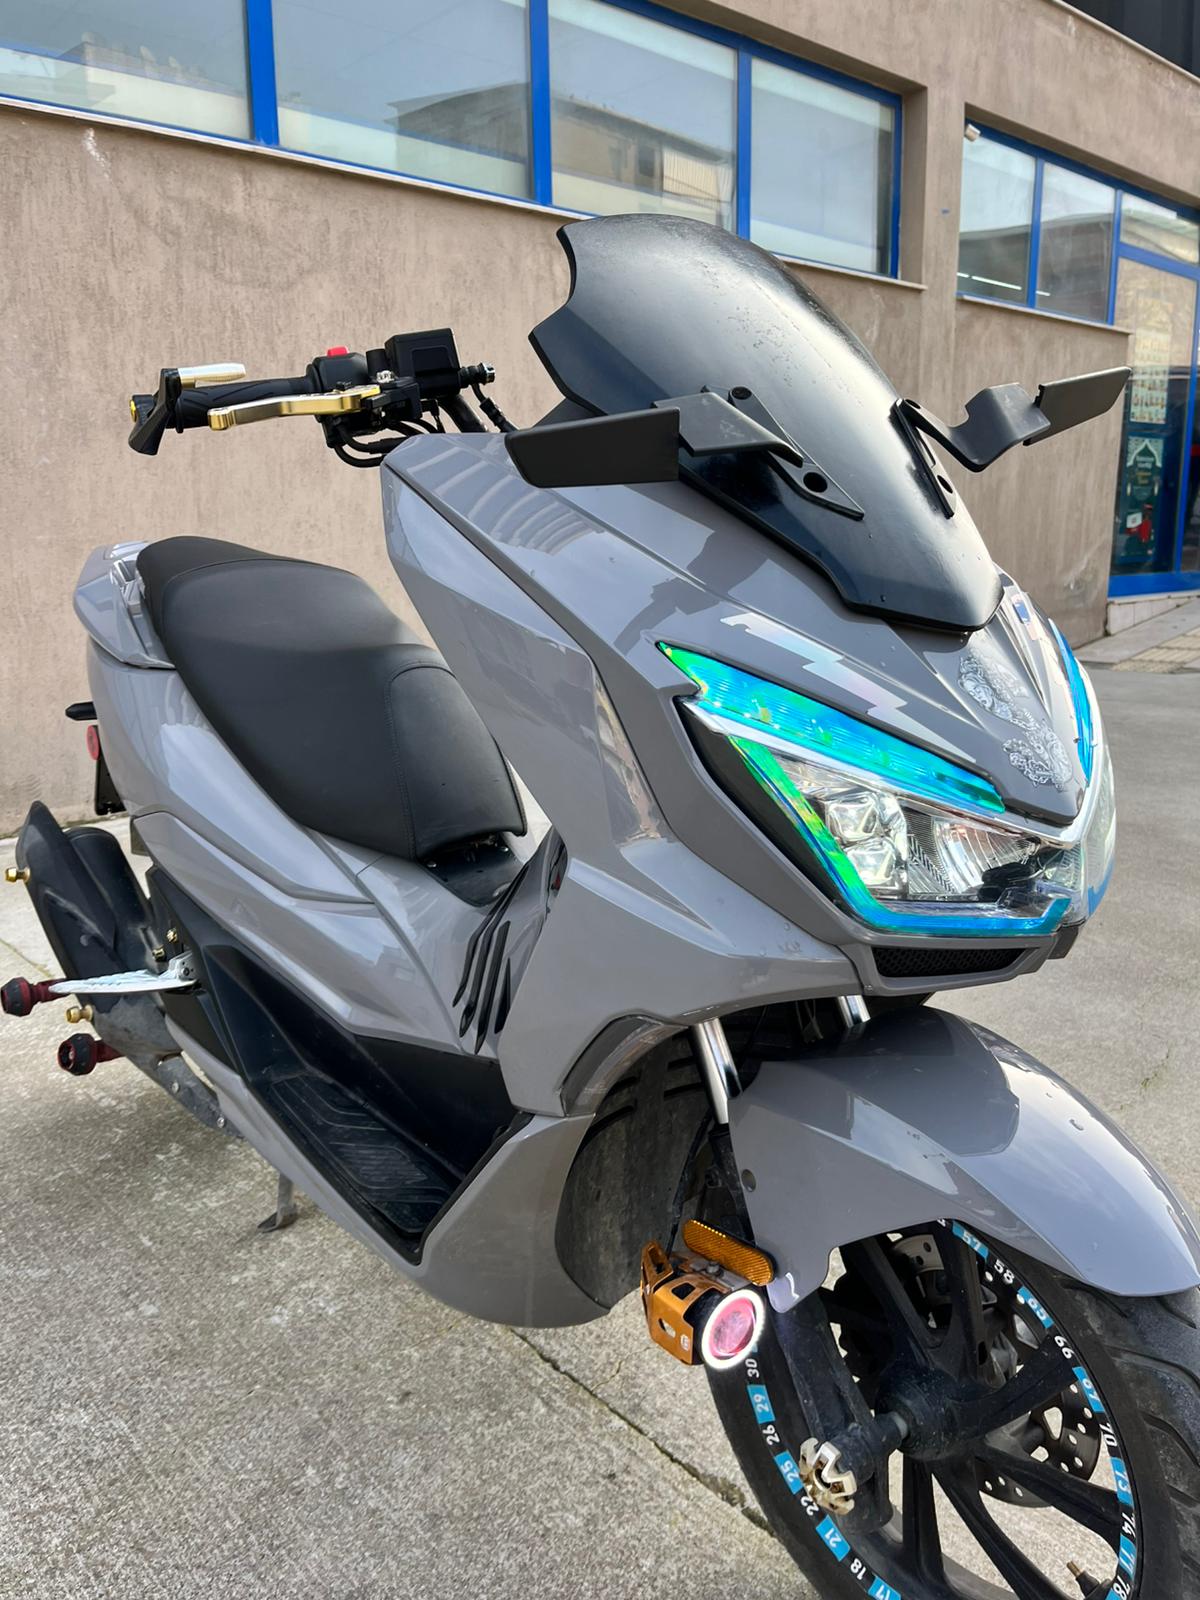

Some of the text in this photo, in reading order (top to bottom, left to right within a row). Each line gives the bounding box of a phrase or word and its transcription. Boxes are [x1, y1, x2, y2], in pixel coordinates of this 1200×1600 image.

[962, 1231, 981, 1250] 57
[994, 1259, 1015, 1284] 58
[1054, 1335, 1075, 1359] 66
[745, 1358, 759, 1378] 30
[754, 1393, 769, 1413] 29
[762, 1424, 780, 1445] 26
[780, 1460, 799, 1482] 25
[800, 1495, 820, 1516] 22
[1122, 1513, 1136, 1538] 74
[824, 1527, 842, 1548] 21
[850, 1558, 867, 1580] 18
